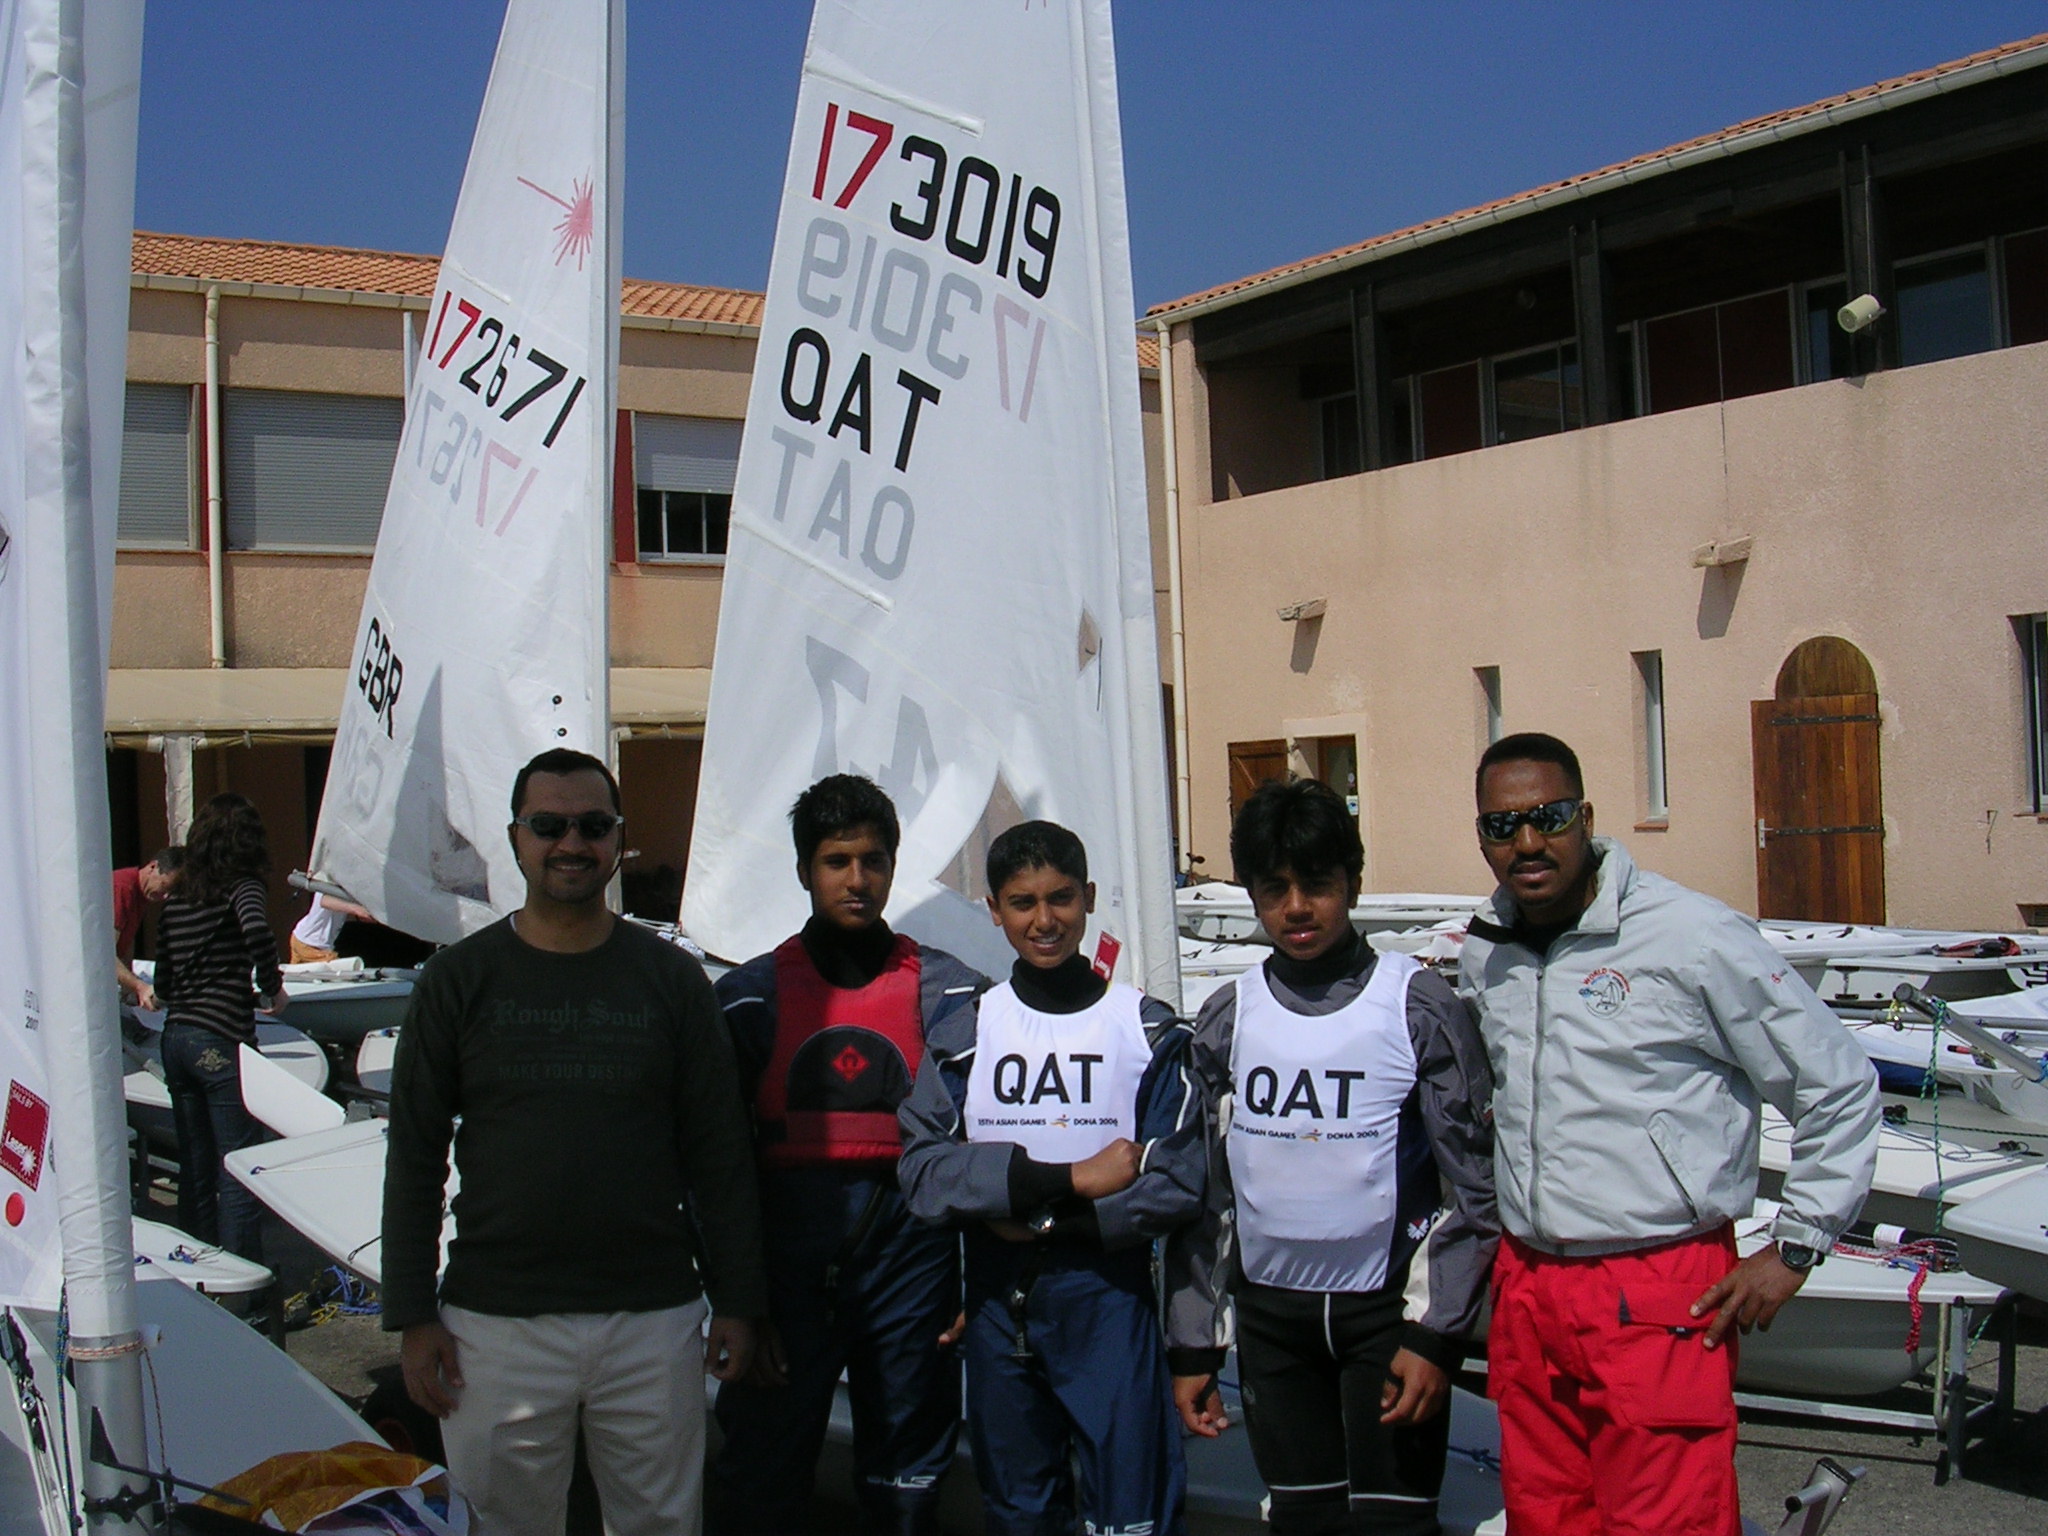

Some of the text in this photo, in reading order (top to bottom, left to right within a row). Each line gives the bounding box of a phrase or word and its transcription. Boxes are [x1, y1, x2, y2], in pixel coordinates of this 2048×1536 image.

[812, 102, 1062, 299] 173019
[427, 290, 587, 449] 172671
[780, 327, 942, 473] QAT
[358, 617, 404, 741] GBR
[992, 1052, 1103, 1105] QAT
[995, 1118, 1018, 1127] ASIAN
[1019, 1118, 1047, 1126] GAMES
[1073, 1118, 1097, 1126] DOHA
[1245, 1065, 1366, 1119] QAT
[1245, 1126, 1266, 1136] ASIAN
[1267, 1129, 1297, 1139] GAMES
[1326, 1131, 1355, 1139] DOHA
[1356, 1130, 1380, 1138] 2006
